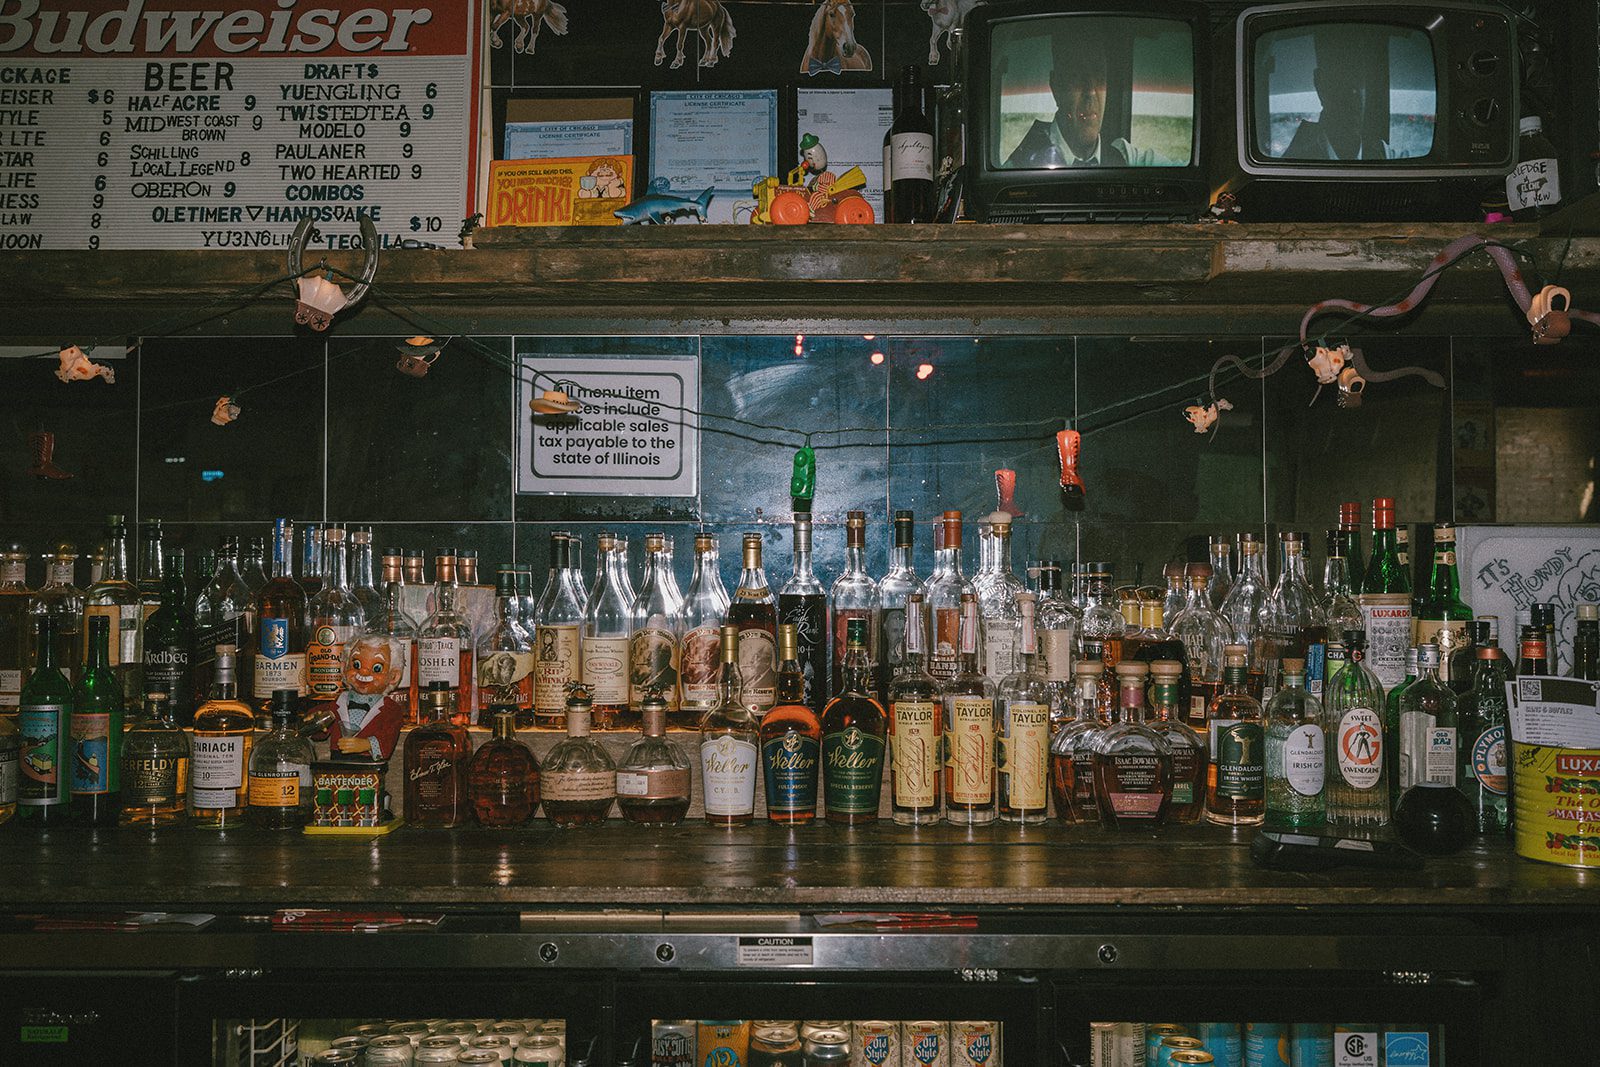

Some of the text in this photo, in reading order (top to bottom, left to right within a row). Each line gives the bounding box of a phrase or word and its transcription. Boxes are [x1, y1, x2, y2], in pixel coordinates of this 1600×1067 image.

[144, 62, 234, 92] BEER
[280, 82, 438, 101] YUENGLING 6
[244, 95, 256, 111] 9
[102, 110, 113, 126] 5
[422, 104, 434, 120] 9
[204, 115, 240, 127] COAST
[252, 115, 263, 131] 9
[299, 122, 411, 138] MODELO 9
[100, 131, 112, 146] 6
[182, 129, 226, 141] BROWN
[240, 151, 251, 167] 8
[275, 143, 413, 159] PAULANER 9
[97, 152, 109, 167] 6
[278, 164, 422, 180] TWO HEARTED 9
[94, 175, 107, 191] 6
[131, 181, 236, 198] OBERON 9
[285, 185, 364, 201] COMBOS
[92, 194, 104, 209] 9
[2, 213, 101, 229] LAW 8
[88, 235, 100, 250] 9
[326, 234, 402, 249] TEQILA
[577, 388, 622, 399] menu
[625, 386, 660, 399] item
[604, 402, 661, 416] include
[546, 419, 669, 435] applicable sales
[539, 435, 675, 451] tax payable to the
[553, 451, 661, 465] state of Illinois
[1500, 546, 1572, 612] HOWDY
[419, 657, 455, 667] OSHER
[516, 691, 528, 703] RACE
[896, 711, 933, 721] TAYLOR
[956, 707, 992, 718] TAYLOR
[1012, 713, 1047, 723] TAYLOR
[1350, 715, 1372, 723] SWEET
[1475, 728, 1505, 761] PLYMO
[705, 752, 750, 774] Weller
[769, 748, 815, 770] Weller
[828, 745, 878, 769] Weller
[1115, 756, 1159, 765] ISAAC BOWMAN
[202, 771, 211, 780] 10
[318, 777, 373, 786] BARTENDER
[281, 785, 295, 796] 12
[1556, 795, 1585, 808] The
[872, 1036, 887, 1049] Old
[922, 1036, 937, 1048] Old
[976, 1036, 990, 1048] Old
[865, 1045, 888, 1062] Style
[915, 1045, 937, 1062] Style
[968, 1045, 990, 1062] Style
